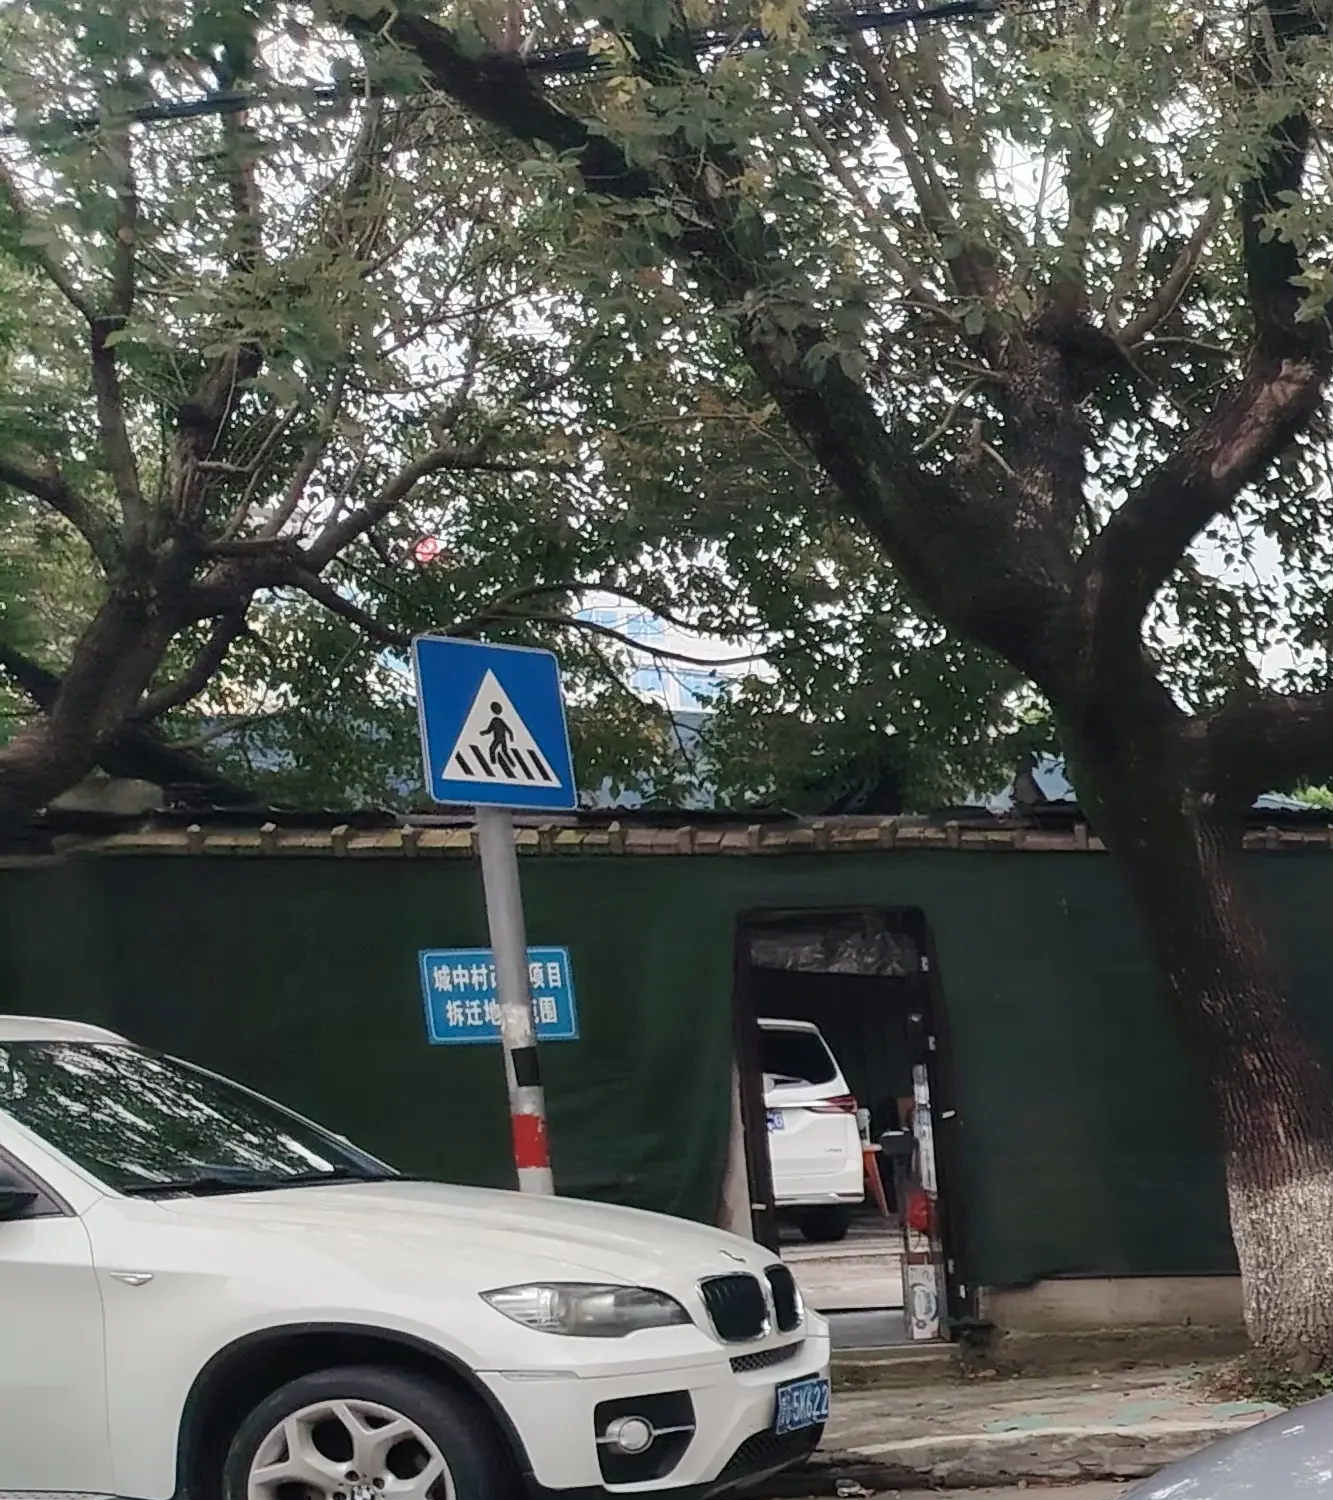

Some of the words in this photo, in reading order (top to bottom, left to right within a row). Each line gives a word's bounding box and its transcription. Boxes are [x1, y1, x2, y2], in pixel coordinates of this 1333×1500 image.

[432, 961, 562, 992] 城中村项目
[446, 996, 558, 1027] 拆迁地围
